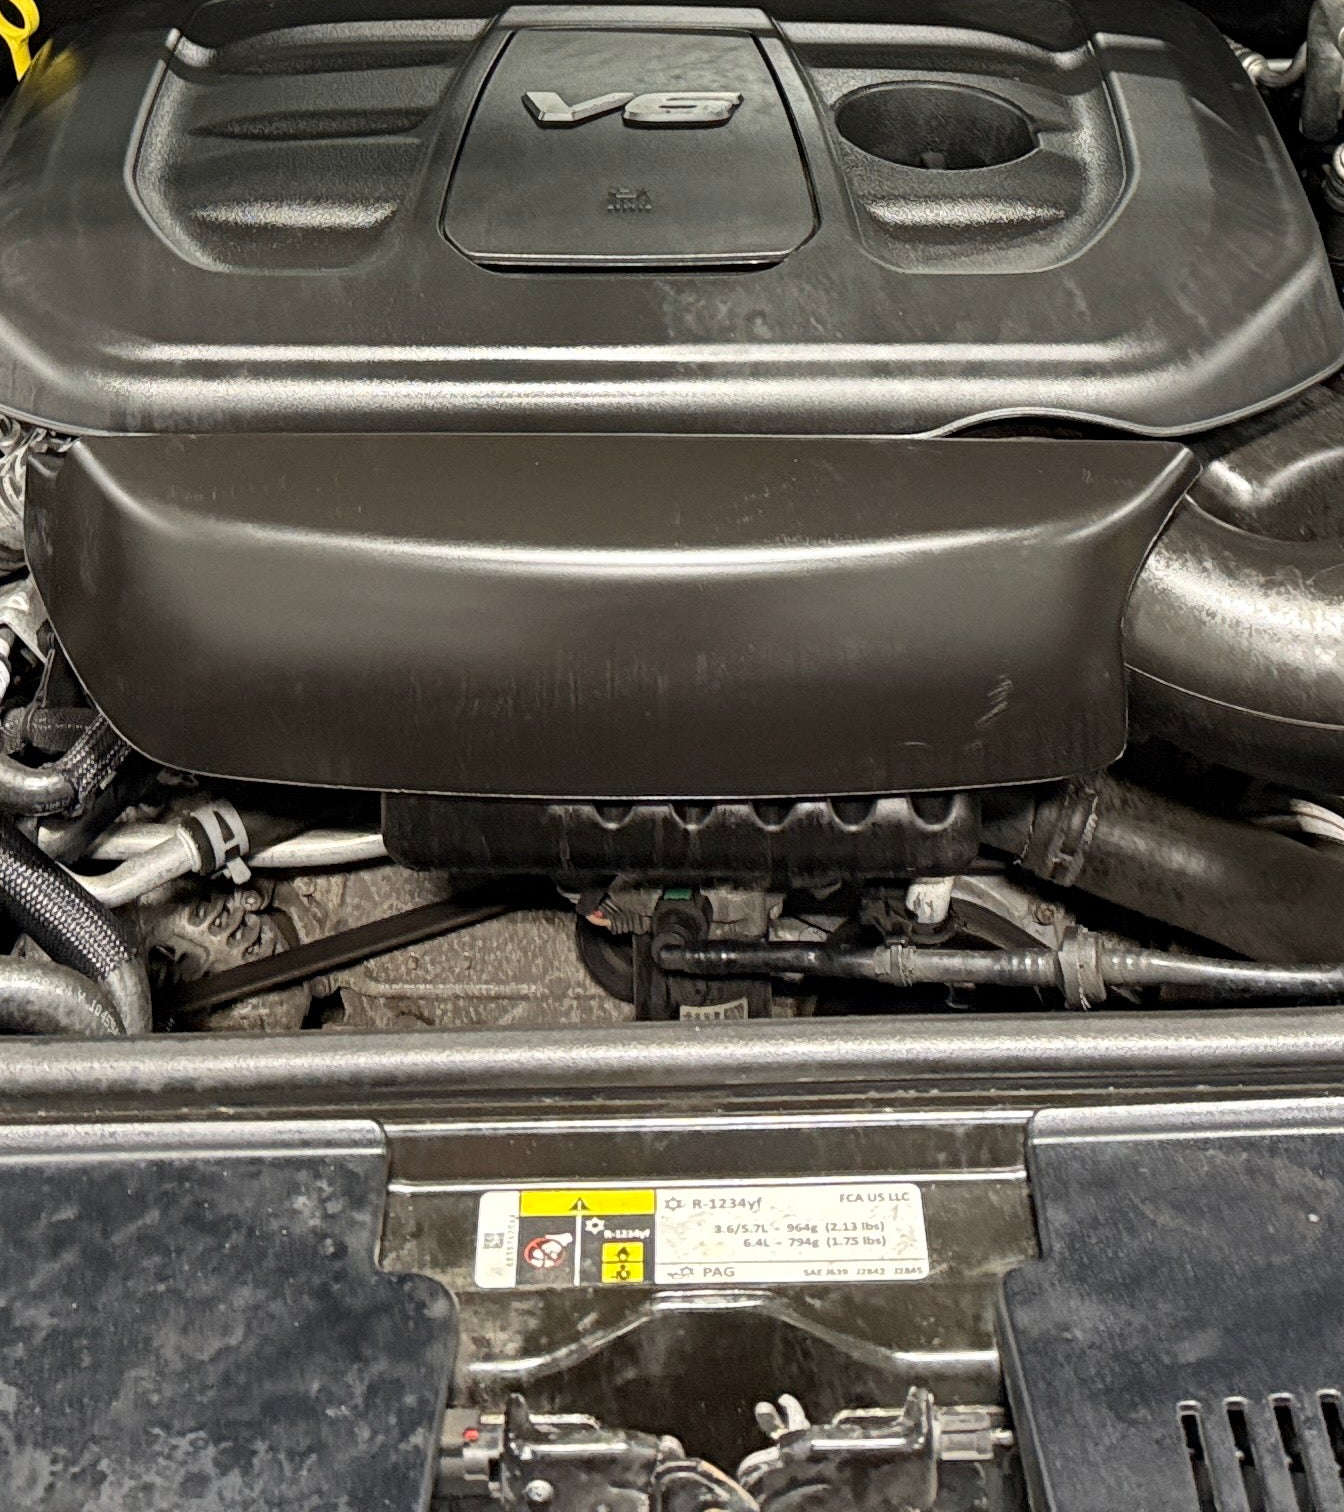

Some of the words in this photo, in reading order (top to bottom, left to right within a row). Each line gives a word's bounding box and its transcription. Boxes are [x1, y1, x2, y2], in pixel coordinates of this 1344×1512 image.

[522, 91, 744, 129] V6
[840, 1193, 864, 1203] FCA
[867, 1192, 885, 1202] US
[889, 1192, 910, 1202] LLC
[692, 1197, 762, 1213] R-1234yf
[714, 1224, 768, 1235] 3.6/5.7L
[786, 1223, 818, 1234] 964g
[825, 1222, 858, 1233] (2.13
[861, 1221, 885, 1233] lbs)
[743, 1238, 770, 1248] 6.4L
[788, 1237, 820, 1248] 794g
[826, 1236, 859, 1248] (1.75
[863, 1235, 887, 1247] lbs)
[703, 1266, 735, 1278] PAG
